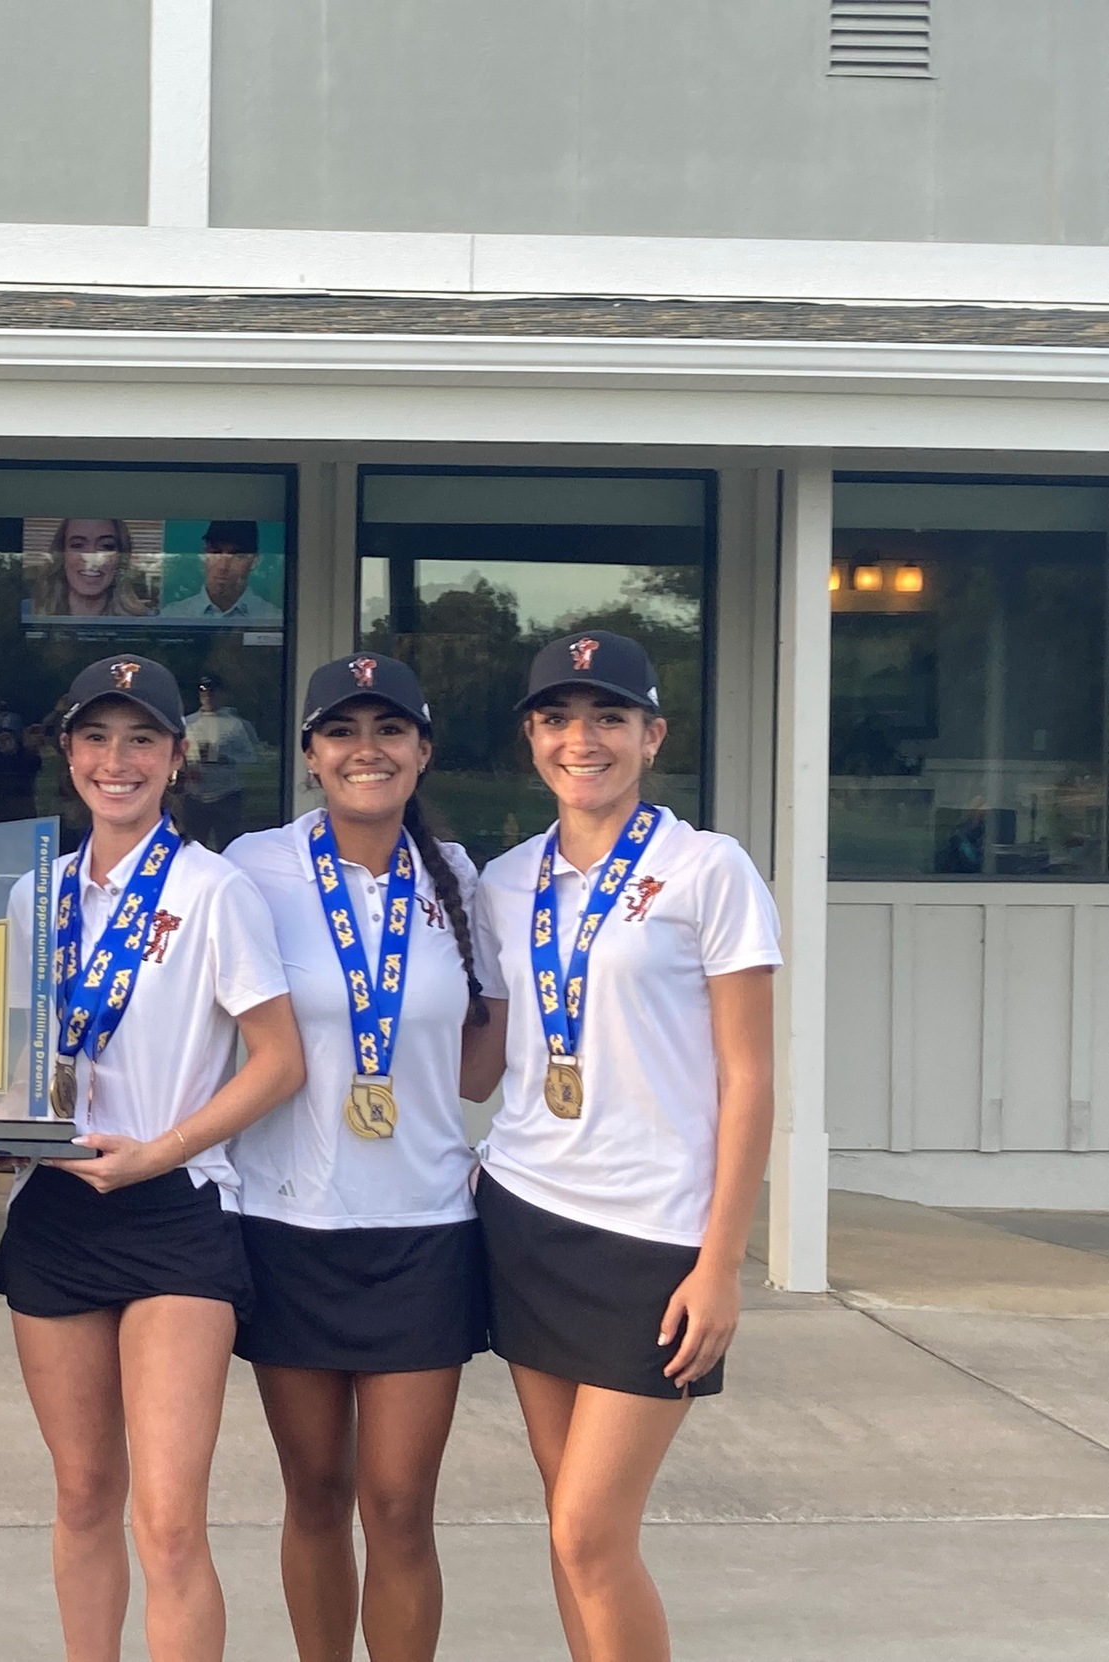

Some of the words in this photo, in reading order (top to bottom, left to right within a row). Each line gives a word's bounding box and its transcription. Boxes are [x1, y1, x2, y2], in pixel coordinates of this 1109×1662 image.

[628, 811, 656, 844] 3C2A
[36, 835, 50, 893] Providing
[140, 843, 169, 876] 3C2A
[316, 853, 340, 894] 3C2A
[600, 857, 632, 896] 3C2A
[112, 893, 143, 929] 3C2A
[331, 908, 355, 949] 3C2A
[389, 897, 409, 936] 3C2A
[534, 908, 552, 949] 3C2A
[577, 912, 603, 953] 3C2A
[84, 950, 113, 987] 3C2A
[382, 953, 402, 993] 3C2A
[108, 969, 133, 1010] 3C2A
[349, 969, 371, 1013] 3C2A
[538, 970, 559, 1014] 3C2A
[566, 976, 583, 1019] 3C2A
[33, 994, 47, 1048] Fulfilling
[66, 1006, 90, 1047] 3C2A
[359, 1032, 379, 1075] 3C2A
[549, 1034, 564, 1055] 3C
